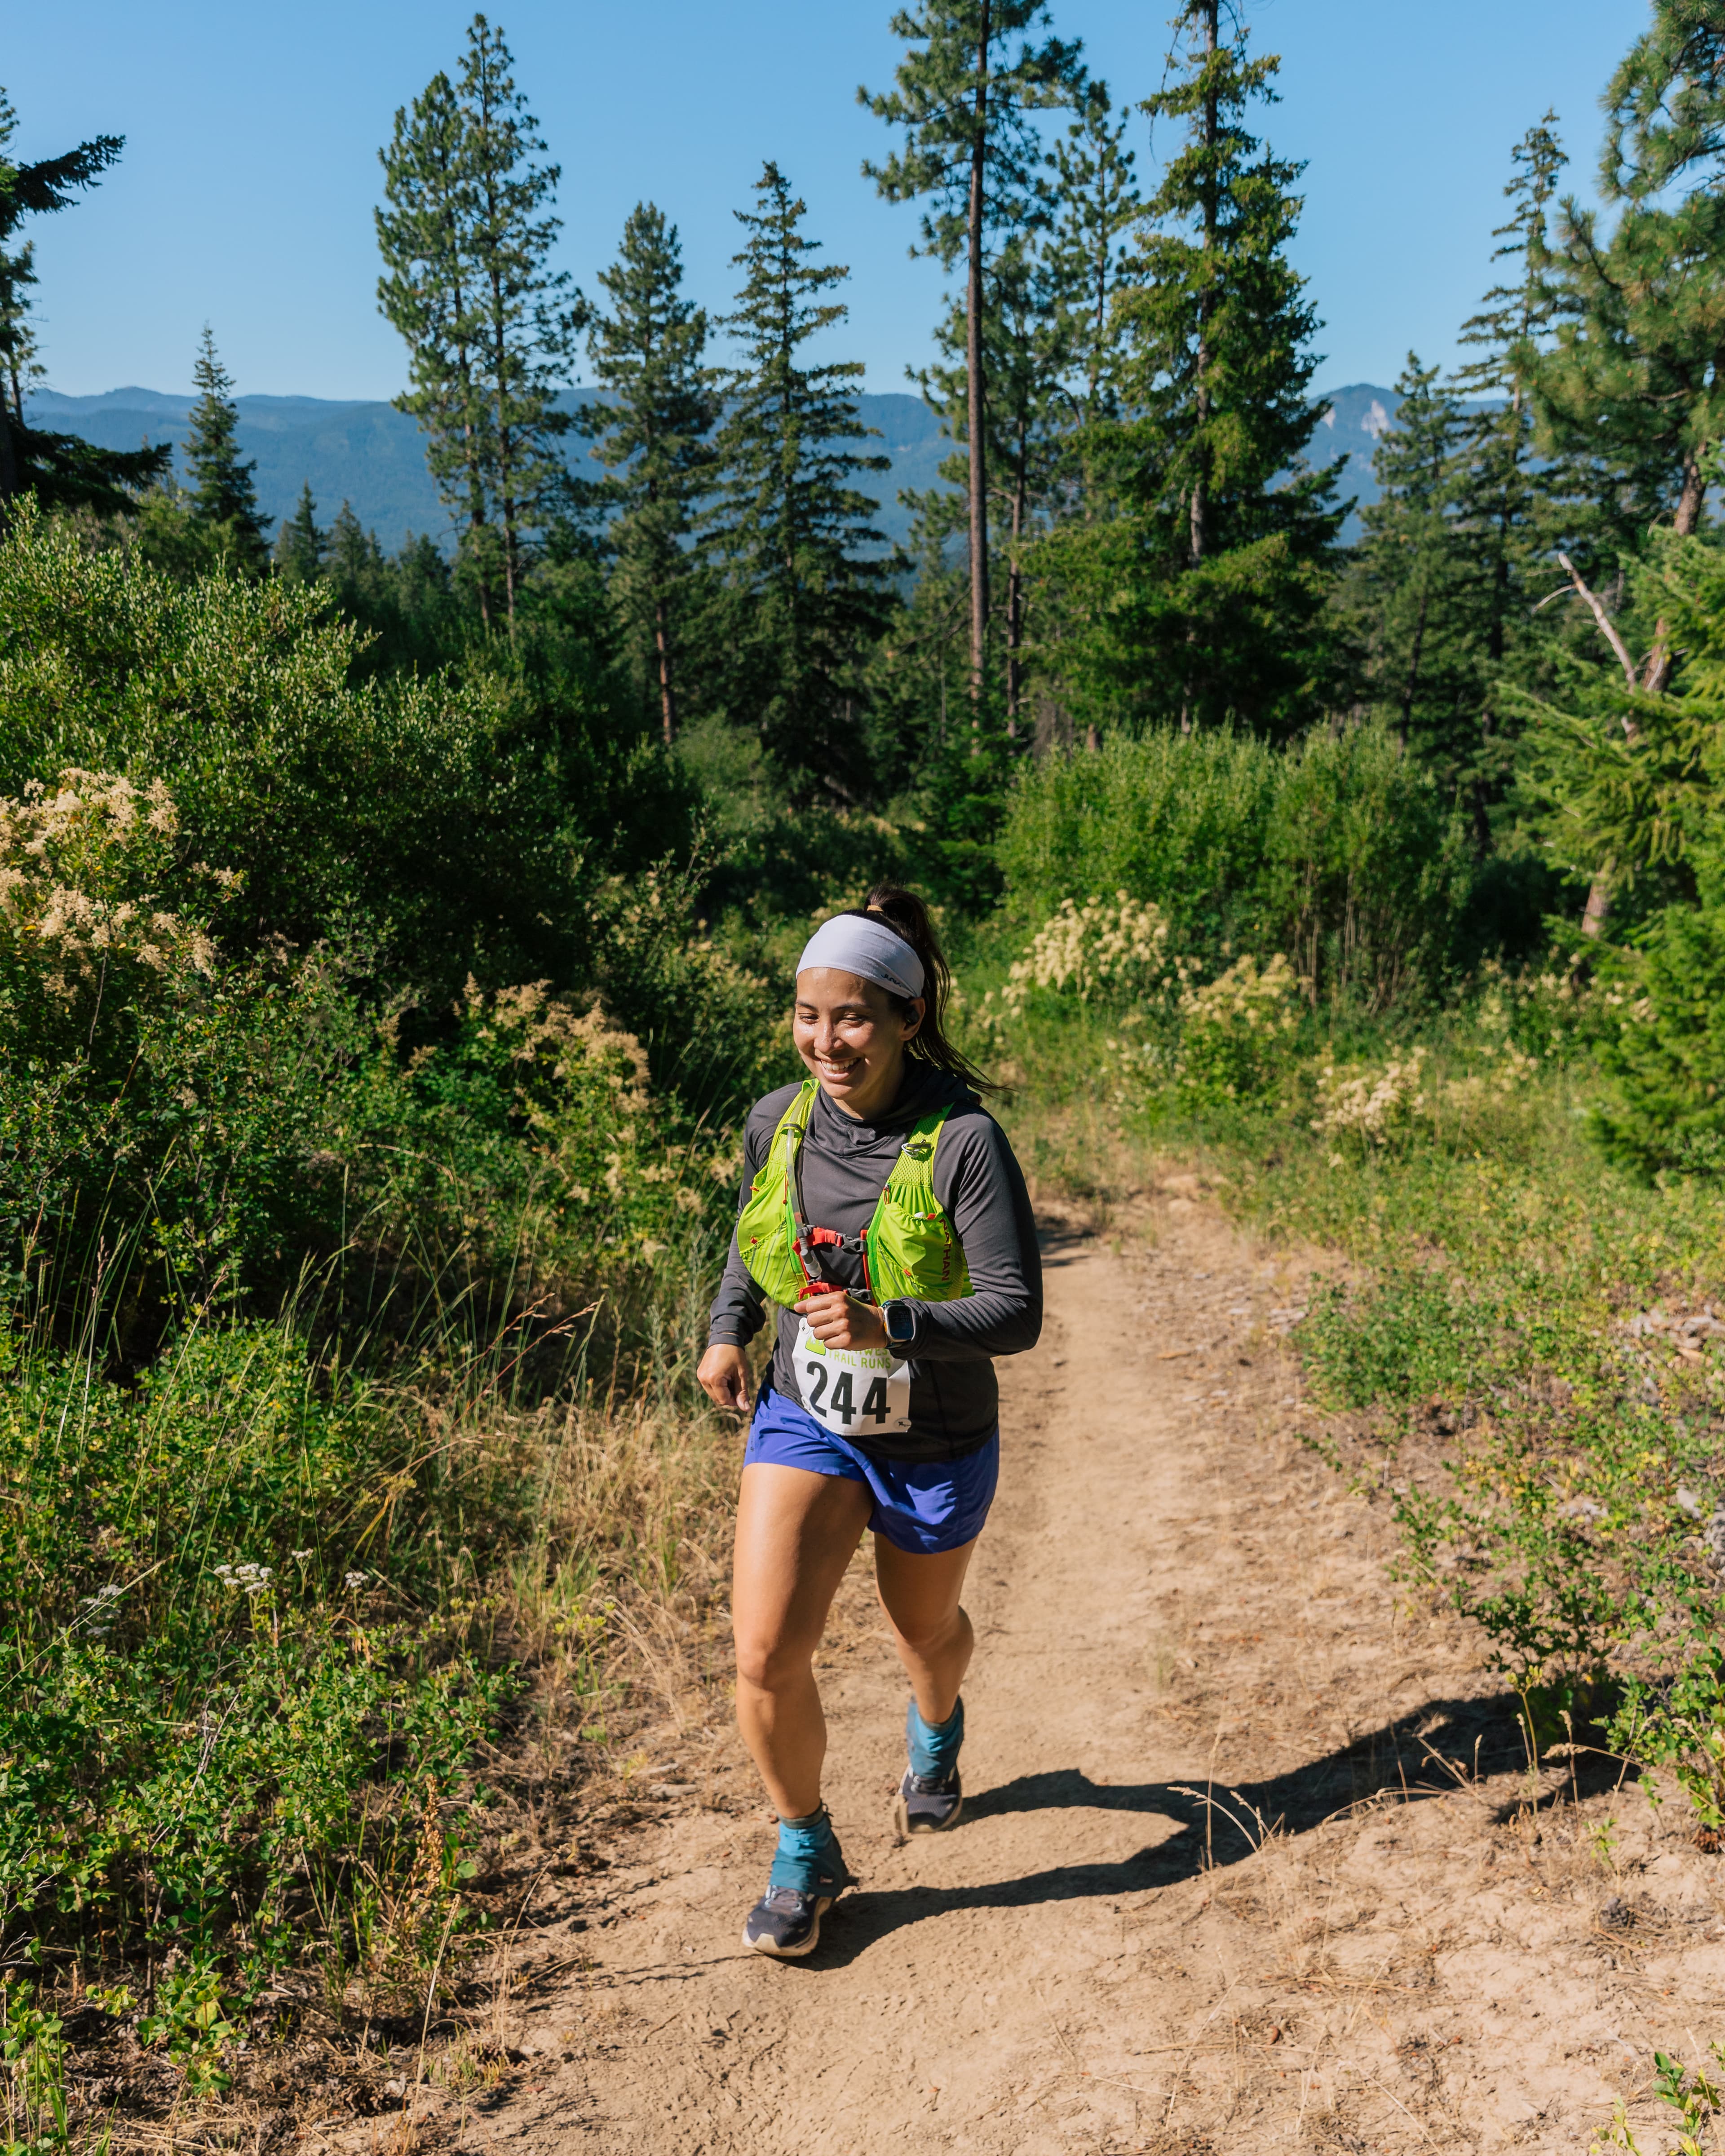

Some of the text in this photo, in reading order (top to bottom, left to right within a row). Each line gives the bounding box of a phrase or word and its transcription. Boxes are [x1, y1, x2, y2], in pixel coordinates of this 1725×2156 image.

[938, 1218, 952, 1281] NATHAN
[829, 1350, 857, 1366] TRAIL
[861, 1357, 891, 1369] RUNS
[806, 1361, 891, 1425] 244
